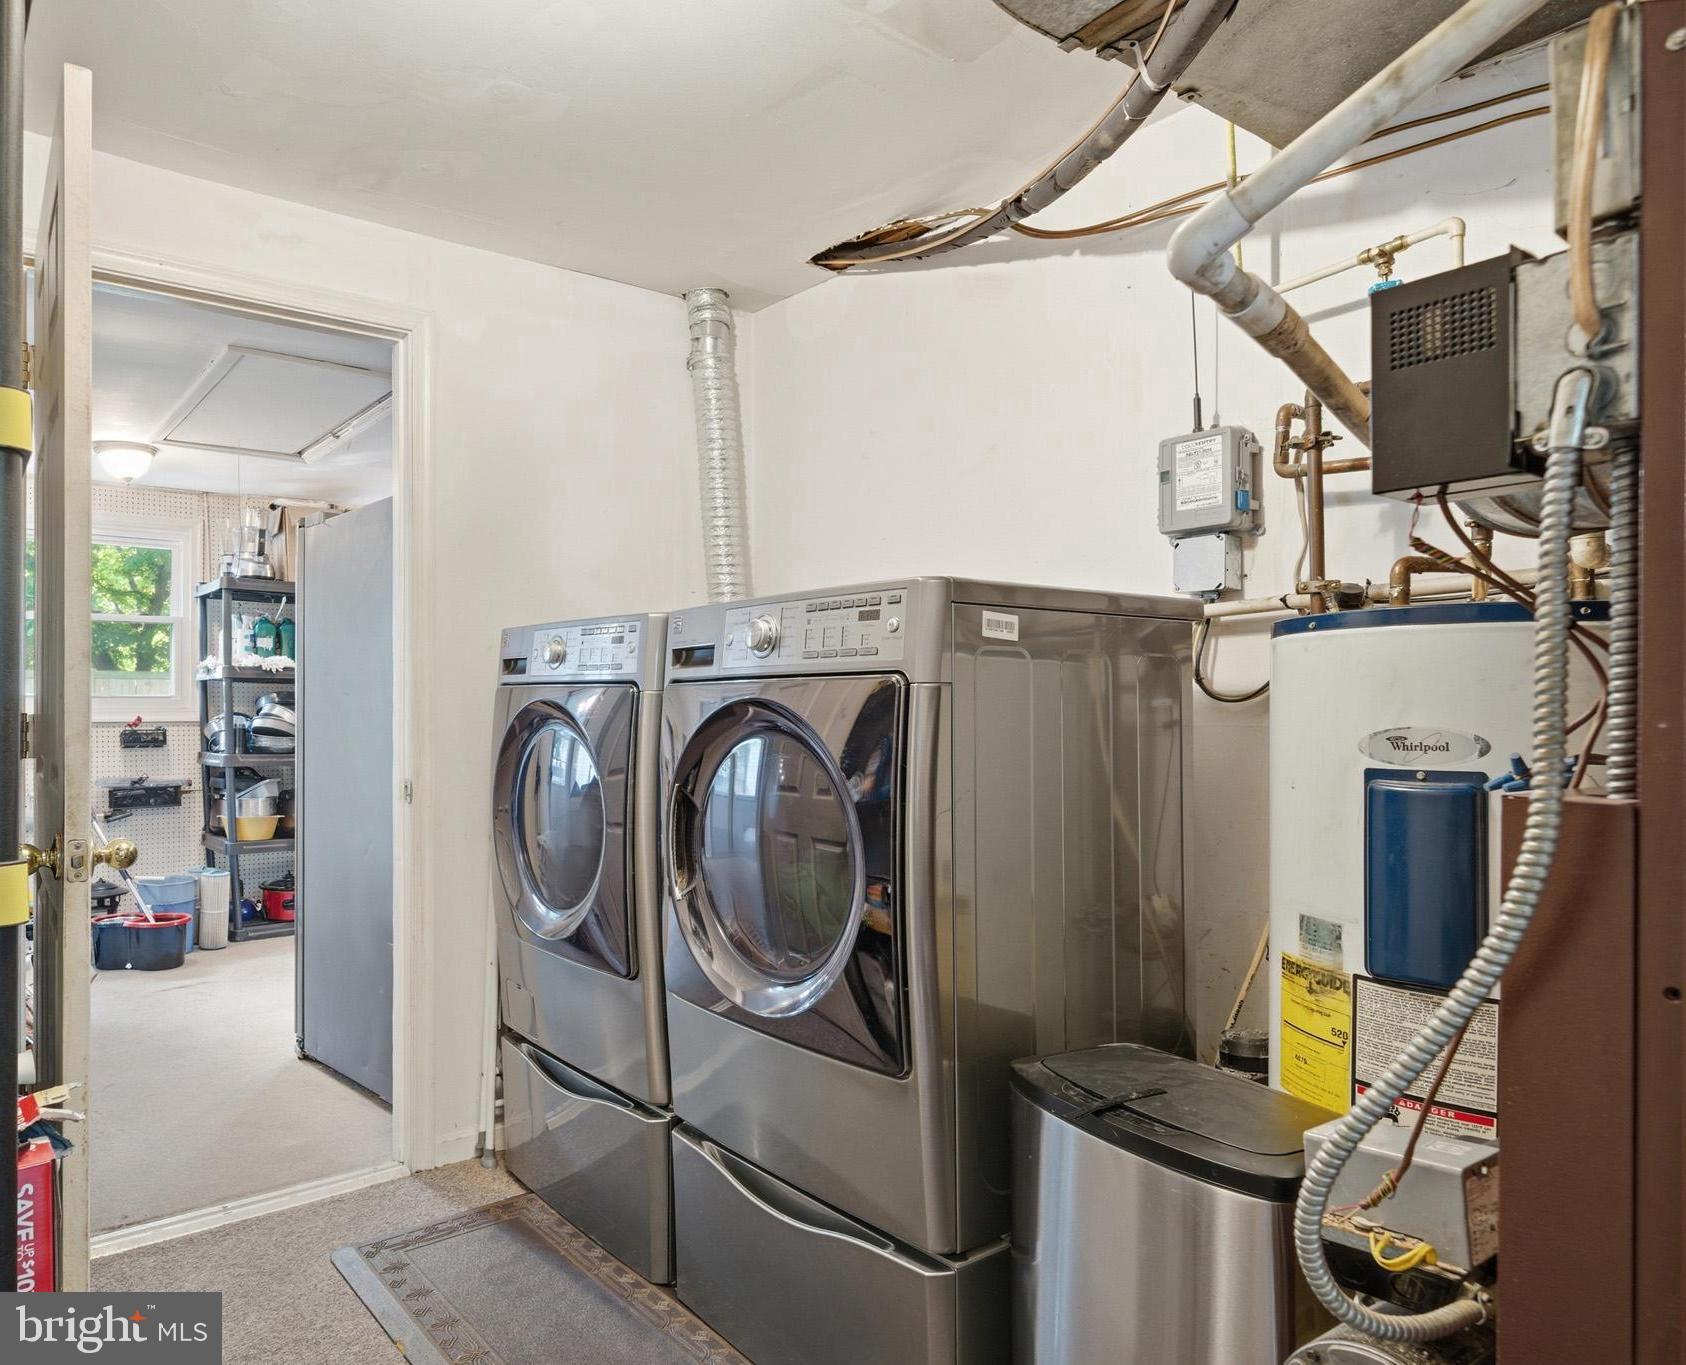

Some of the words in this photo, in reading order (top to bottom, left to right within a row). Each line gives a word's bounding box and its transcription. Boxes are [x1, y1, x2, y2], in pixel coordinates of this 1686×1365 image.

[1391, 742, 1450, 754] Whirlpool
[1331, 1027, 1348, 1040] 520
[1406, 1101, 1456, 1118] DAGER
[17, 1183, 34, 1241] SAVE
[24, 1243, 35, 1258] UP
